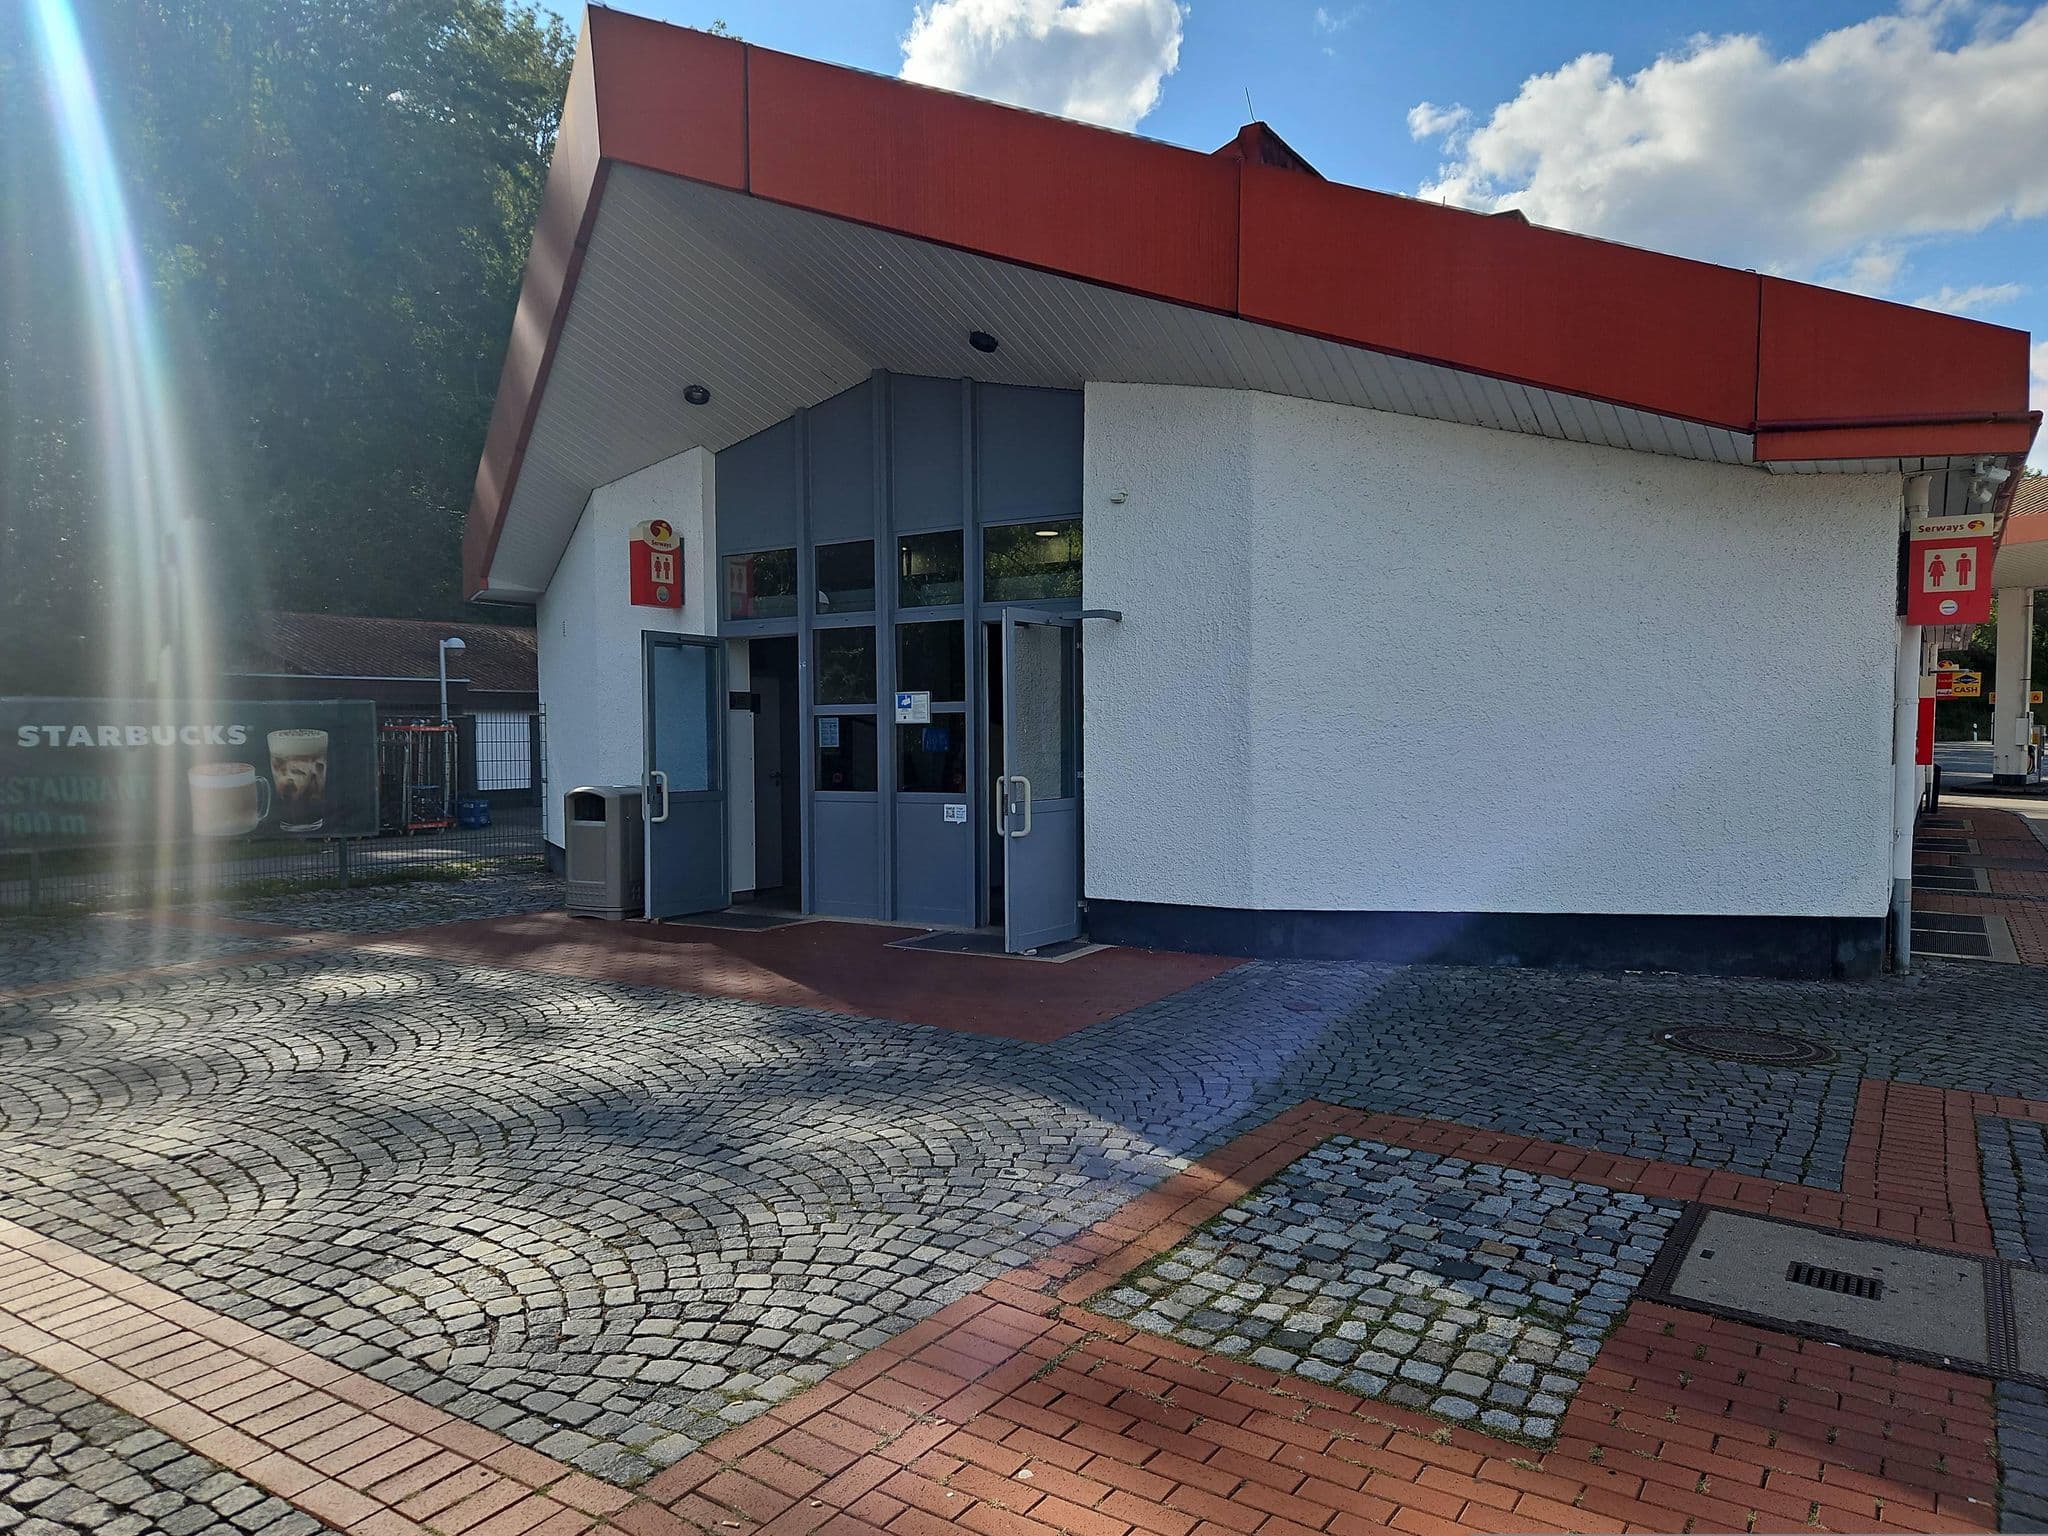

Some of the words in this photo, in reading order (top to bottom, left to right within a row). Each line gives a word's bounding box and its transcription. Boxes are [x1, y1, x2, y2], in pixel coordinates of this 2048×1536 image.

[1918, 523, 1964, 533] Serways
[651, 539, 672, 549] Serways
[17, 724, 248, 748] STARBUCKS
